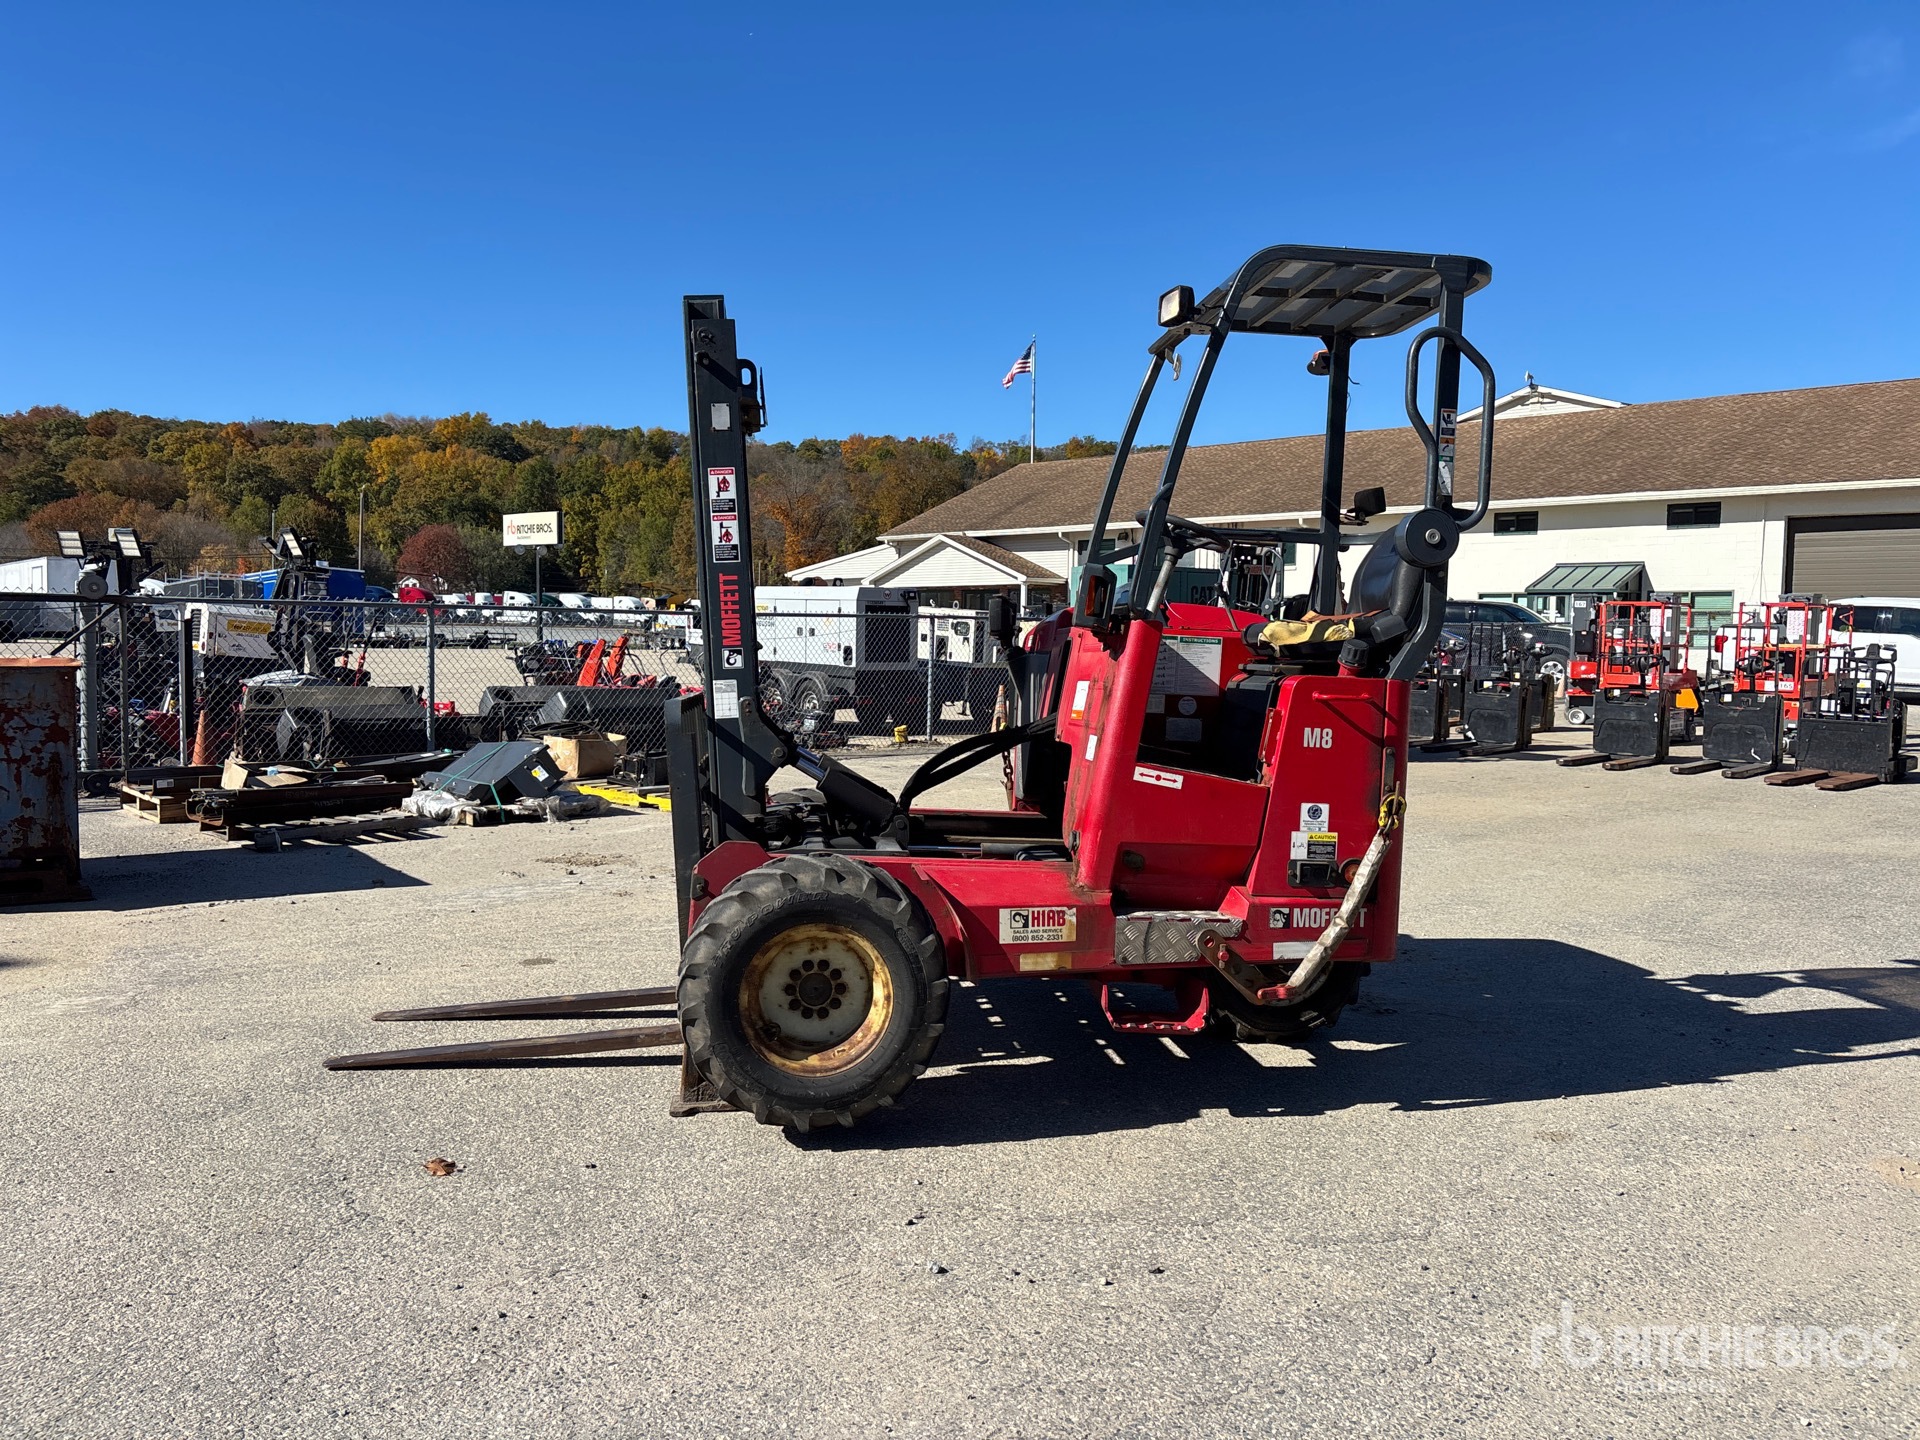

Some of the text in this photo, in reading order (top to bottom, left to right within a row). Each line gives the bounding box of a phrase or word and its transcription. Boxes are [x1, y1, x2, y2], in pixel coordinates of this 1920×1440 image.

[517, 524, 535, 534] RITCHIE
[719, 573, 741, 646] MOFFETT
[1303, 727, 1333, 749] M8
[1031, 910, 1066, 928] HIAB
[1293, 907, 1368, 928] MOFFT
[1012, 934, 1029, 942] (800)
